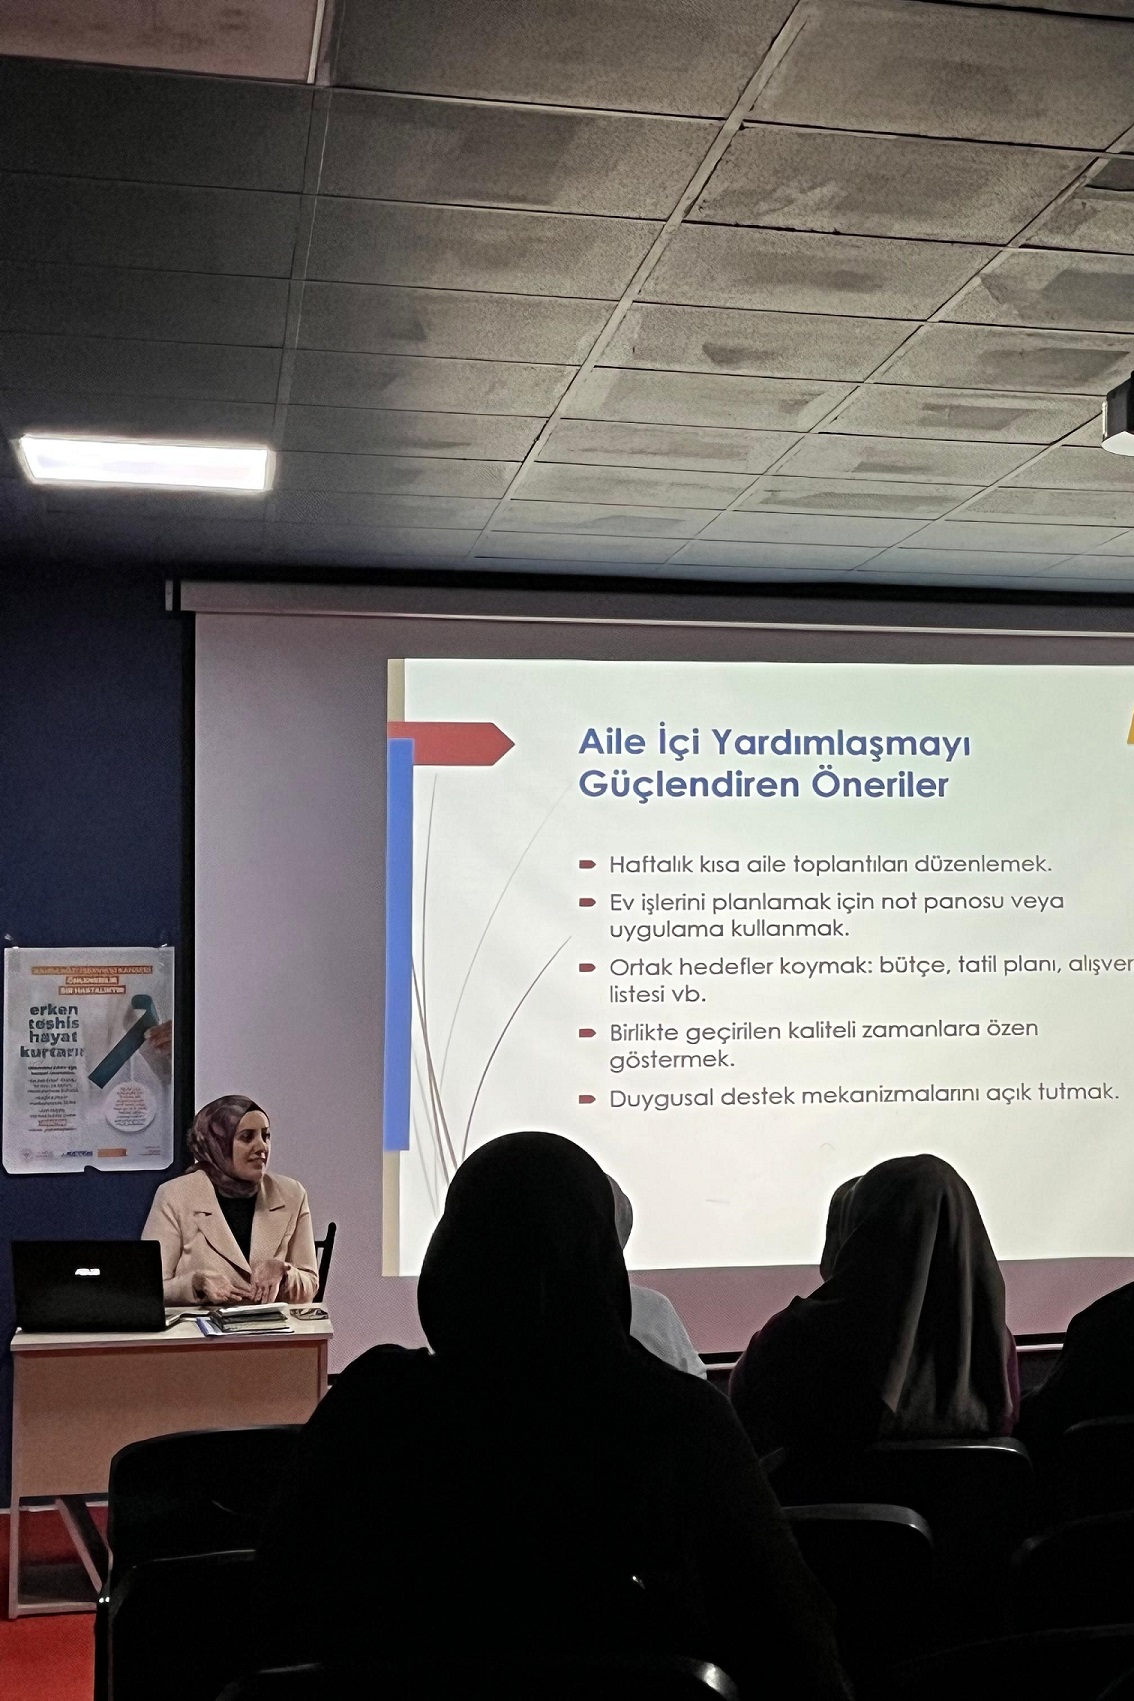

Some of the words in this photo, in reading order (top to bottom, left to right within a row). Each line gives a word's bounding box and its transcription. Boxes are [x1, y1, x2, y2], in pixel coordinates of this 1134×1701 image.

[578, 726, 646, 755] Aile
[659, 720, 700, 762] İçi
[711, 726, 971, 763] Yardımlaşmayı
[578, 768, 800, 805] Güçlendiren
[811, 763, 950, 799] Öneriler
[610, 854, 694, 874] Haftalık
[699, 854, 740, 873] kısa
[746, 854, 787, 873] aile
[792, 854, 908, 877] toplantıları
[914, 854, 1052, 873] düzenlemek.
[610, 893, 635, 912] Ev
[641, 892, 706, 916] işlerini
[712, 891, 832, 916] planlamak
[836, 891, 875, 915] için
[881, 891, 918, 910] not
[924, 895, 1005, 914] panosu
[1010, 895, 1064, 913] veya
[609, 919, 724, 943] uygulama
[731, 918, 850, 938] kullanmak.
[609, 957, 674, 977] Ortak
[679, 956, 774, 976] hedefler
[779, 955, 873, 980] koymak:
[879, 955, 951, 978] bütçe,
[957, 954, 997, 973] tatil
[1003, 954, 1062, 977] planı,
[609, 984, 665, 1004] listesi
[671, 983, 707, 1003] vb.
[29, 1003, 79, 1016] erken
[29, 1030, 78, 1046] hayat
[610, 1022, 679, 1042] Birlikte
[685, 1021, 781, 1045] geçirilen
[788, 1020, 857, 1039] kaliteli
[861, 1019, 980, 1039] zamanlara
[986, 1018, 1039, 1037] özen
[609, 1048, 735, 1074] göstermek.
[610, 1087, 714, 1112] Duygusal
[720, 1085, 796, 1106] destek
[801, 1083, 980, 1105] mekanizmalarını
[986, 1082, 1033, 1106] açık
[1037, 1082, 1120, 1101] tutmak.
